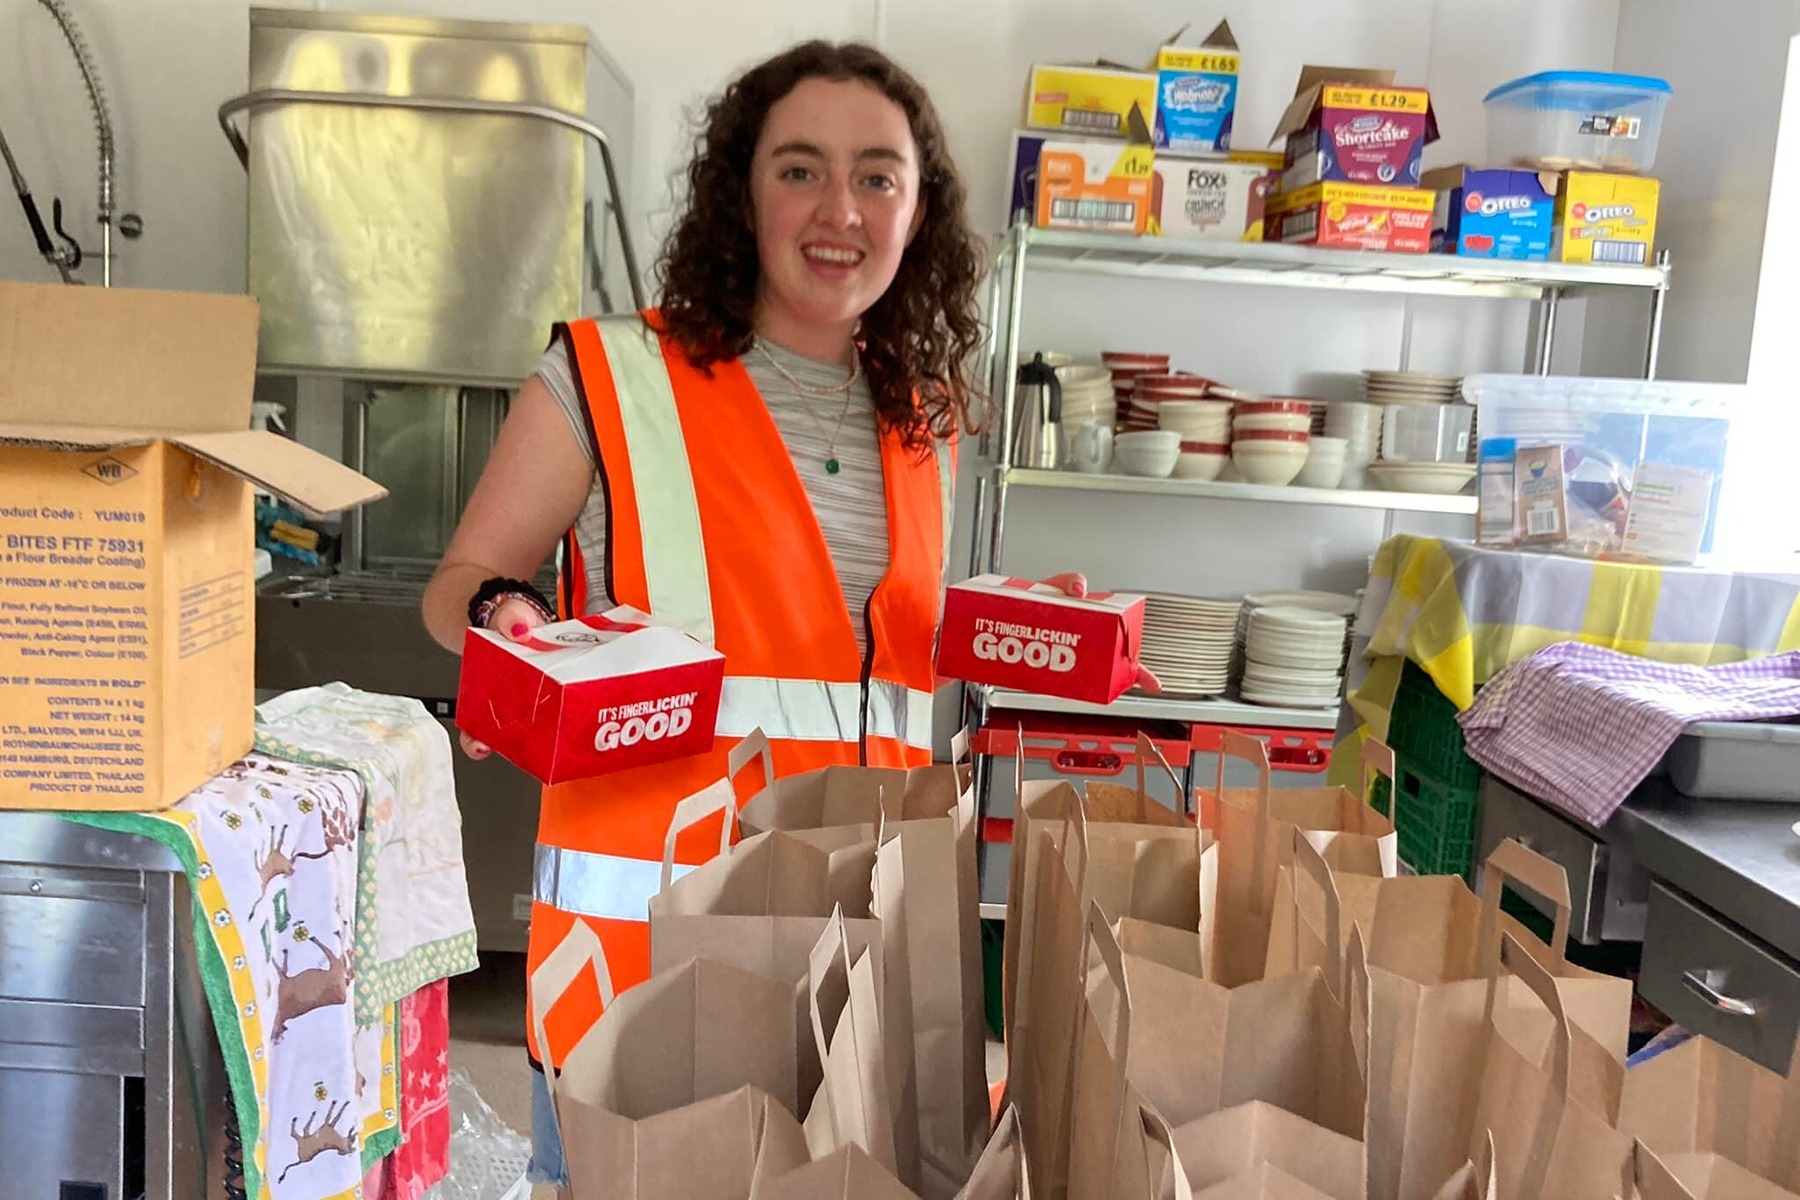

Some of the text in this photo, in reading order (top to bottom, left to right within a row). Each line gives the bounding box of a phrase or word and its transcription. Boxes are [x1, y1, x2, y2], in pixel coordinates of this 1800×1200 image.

[1370, 94, 1406, 108] £1.29
[1336, 121, 1409, 147] Shortcake
[1185, 199, 1224, 212] CRUNCH
[1481, 197, 1531, 216] OREO
[1586, 207, 1634, 223] OREO
[97, 464, 121, 478] WB
[41, 507, 75, 519] Code
[94, 510, 146, 523] YUM019
[7, 534, 144, 553] BITES FTF 75931
[6, 552, 146, 569] a Flour Breader Coating)
[6, 578, 46, 587] FROZEN
[49, 579, 60, 588] AT
[92, 581, 106, 590] OR
[109, 581, 146, 591] BELOW
[976, 617, 995, 633] IT'S
[973, 632, 1077, 673] GOOD
[35, 678, 97, 687] INGREDIENTS
[47, 696, 101, 706] CONTENTS
[133, 700, 145, 709] kg
[50, 711, 69, 721] NET
[72, 712, 111, 721] WEIGHT
[133, 715, 145, 724] kg
[597, 706, 618, 723] IT'S
[28, 726, 77, 736] MALVERN,
[79, 728, 105, 736] WR14
[594, 708, 693, 753] GOOD
[20, 755, 72, 765] HAMBURG,
[74, 757, 144, 766] DEUTSCHLAND
[4, 769, 145, 781] COMPANY LIMITED, THAILAND
[30, 783, 145, 794] PRODUCT OF THAILAND
